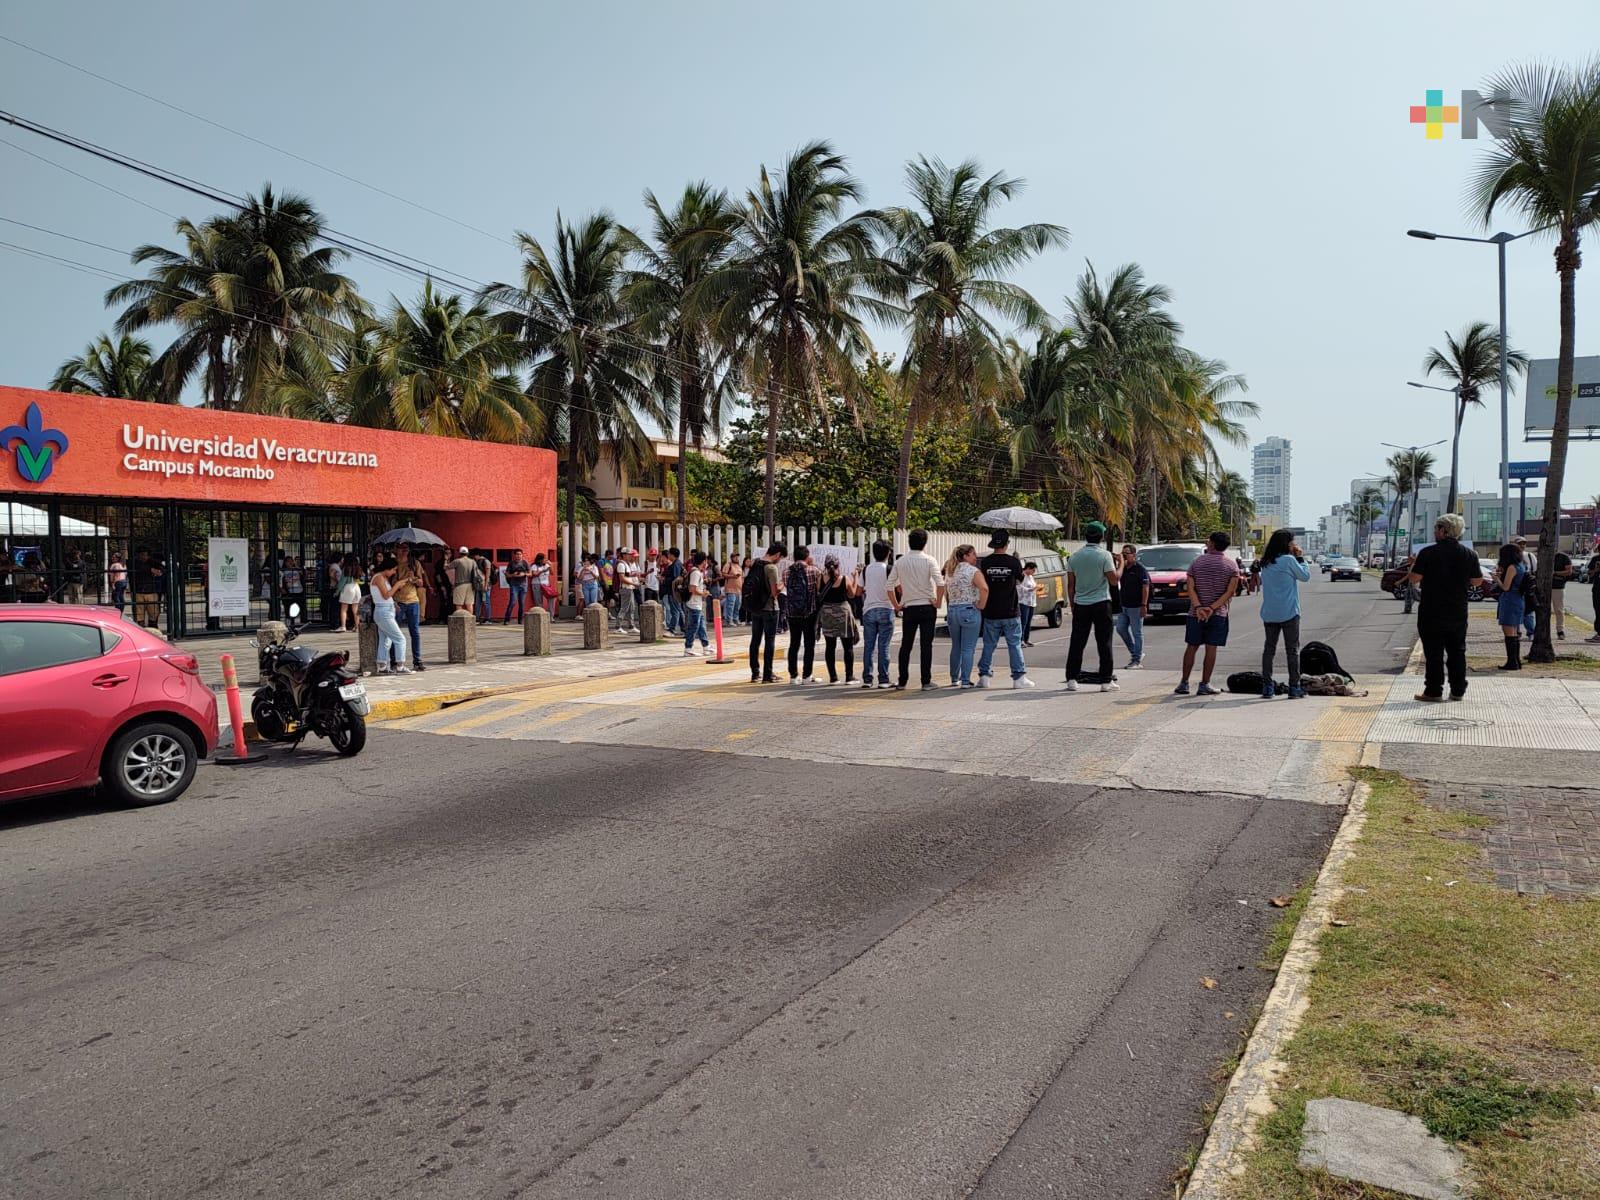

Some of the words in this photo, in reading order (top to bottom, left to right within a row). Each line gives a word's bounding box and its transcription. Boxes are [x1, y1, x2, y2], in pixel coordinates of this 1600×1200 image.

[123, 424, 258, 459] Universidad
[261, 438, 378, 467] Veracruzana
[123, 453, 194, 478] Campus
[199, 459, 274, 480] Mocambo
